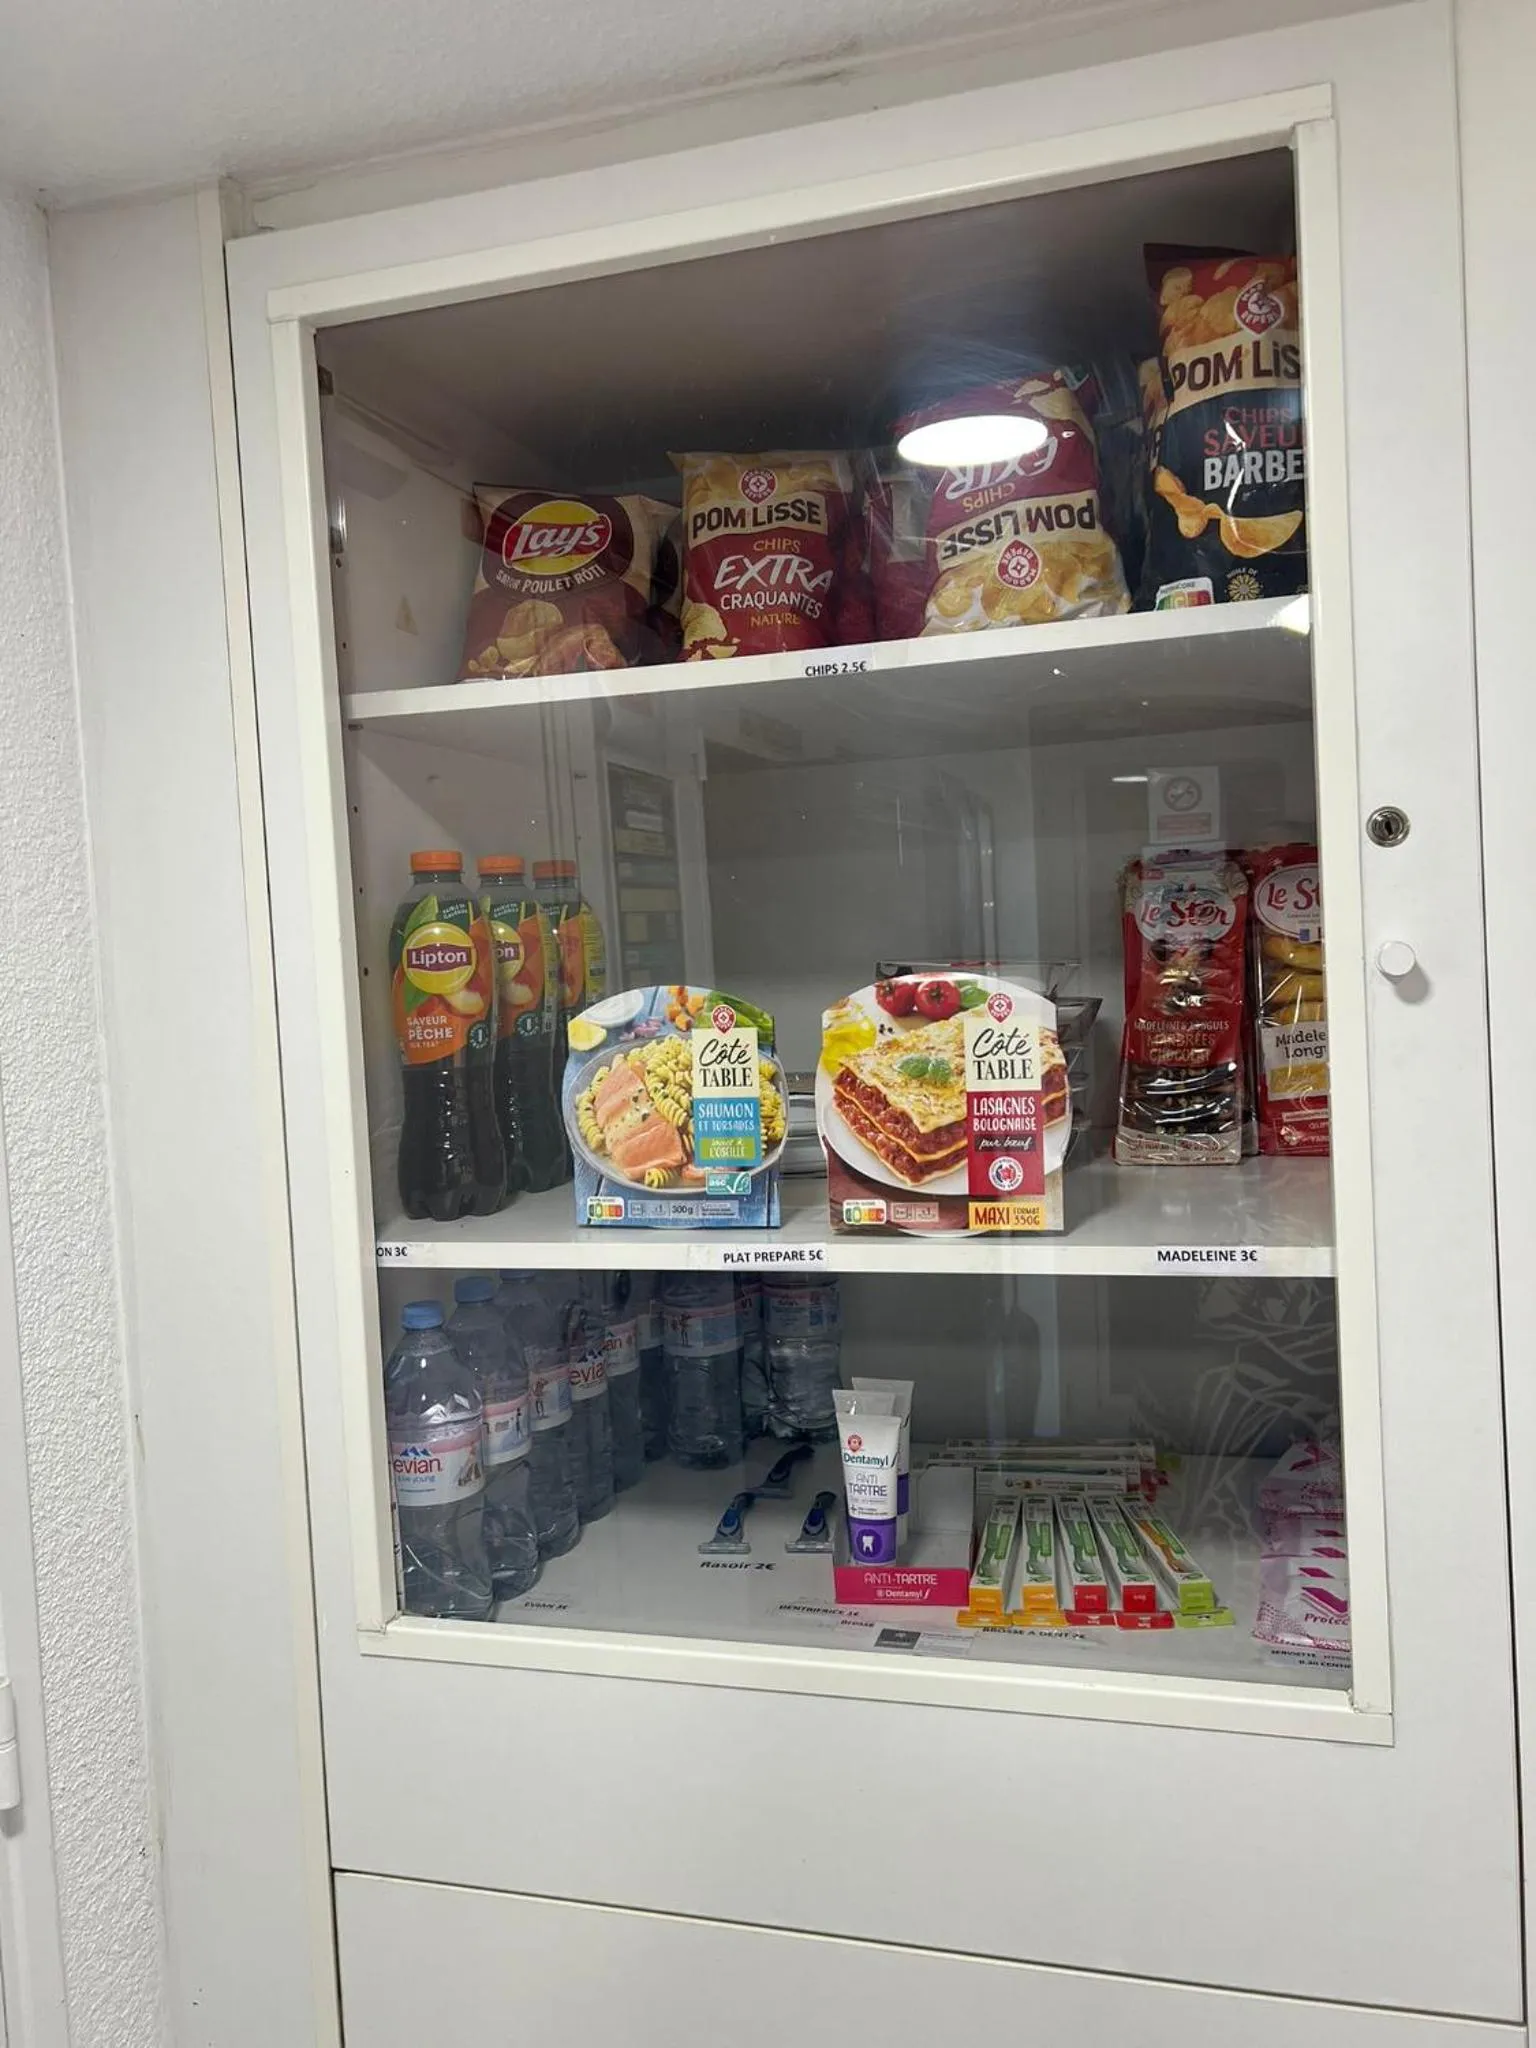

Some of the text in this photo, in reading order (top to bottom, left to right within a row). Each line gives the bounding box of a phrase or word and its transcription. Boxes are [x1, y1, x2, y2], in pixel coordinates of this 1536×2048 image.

[1224, 406, 1293, 424] CHIPS
[1204, 424, 1303, 456] SAVEU
[962, 482, 1015, 512] CHIPS
[693, 506, 746, 540] POM
[1026, 499, 1096, 533] POM
[511, 521, 605, 560] Lay's
[753, 537, 801, 553] CHIPS
[714, 554, 833, 593] EXTRA
[521, 576, 572, 594] POULET
[720, 590, 823, 620] CRAQUANTES
[750, 612, 801, 628] NATURE
[805, 660, 867, 677] CHIPS 2.5€
[1267, 882, 1288, 911] Le
[1140, 899, 1160, 928] Le
[411, 950, 468, 968] Lipton
[406, 1015, 447, 1026] SAVEUR
[407, 1025, 453, 1041] PÊCHE
[972, 1027, 1032, 1059] Côté
[699, 1038, 752, 1067] Côté
[699, 1067, 753, 1088] TABLE
[973, 1058, 1034, 1080] TABLE
[698, 1102, 754, 1118] SAUMON
[973, 1096, 1036, 1115] LASAGNES
[698, 1120, 709, 1131] ET
[973, 1116, 1037, 1132] BOLOGNAISE
[979, 1138, 1001, 1149] pur
[974, 1207, 1010, 1225] MAXI
[376, 1246, 408, 1257] ON 3€
[723, 1249, 824, 1264] PLAT PREPARE 5€
[1157, 1249, 1258, 1262] MADELEINE 3€
[393, 1456, 442, 1474] evian
[843, 1452, 889, 1467] Dentamyl
[856, 1472, 879, 1484] ANTI
[848, 1482, 888, 1497] TARTRE
[700, 1561, 777, 1571] Rasoir 2€
[885, 1588, 923, 1599] Dentamyl
